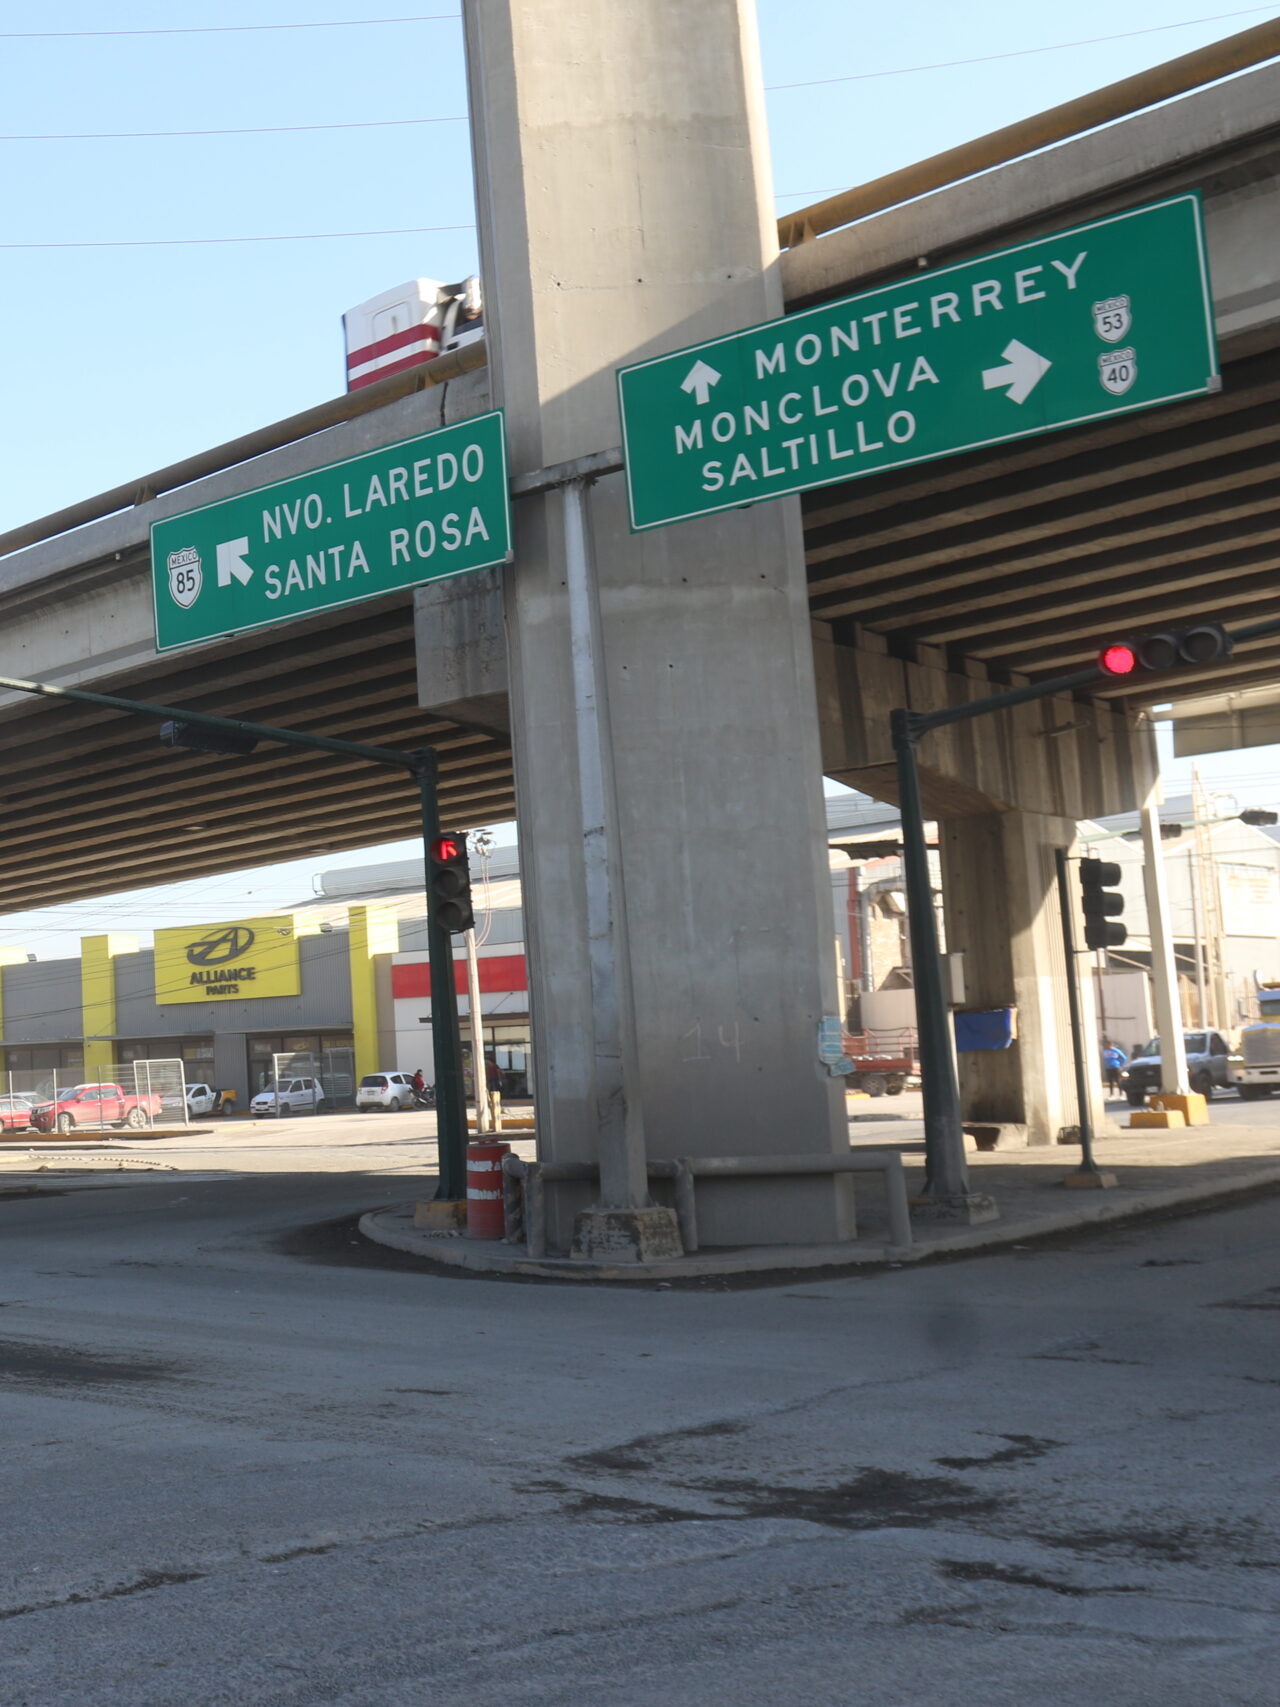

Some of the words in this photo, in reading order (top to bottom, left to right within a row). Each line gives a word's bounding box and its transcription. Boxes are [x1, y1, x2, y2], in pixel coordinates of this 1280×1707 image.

[755, 251, 1087, 380] MONTERREY
[1102, 313, 1123, 333] 53
[1107, 365, 1129, 384] 40
[674, 355, 940, 455] MONCLOVA
[702, 410, 916, 492] SALTILLO
[262, 493, 332, 544] NVO.
[343, 443, 484, 518] LAREDO
[171, 551, 198, 566] MEXICO
[264, 540, 370, 600] SANTA
[390, 506, 490, 566] ROSA
[176, 569, 196, 594] 85
[189, 966, 256, 985] ALLIANCE
[205, 983, 240, 996] PARTS
